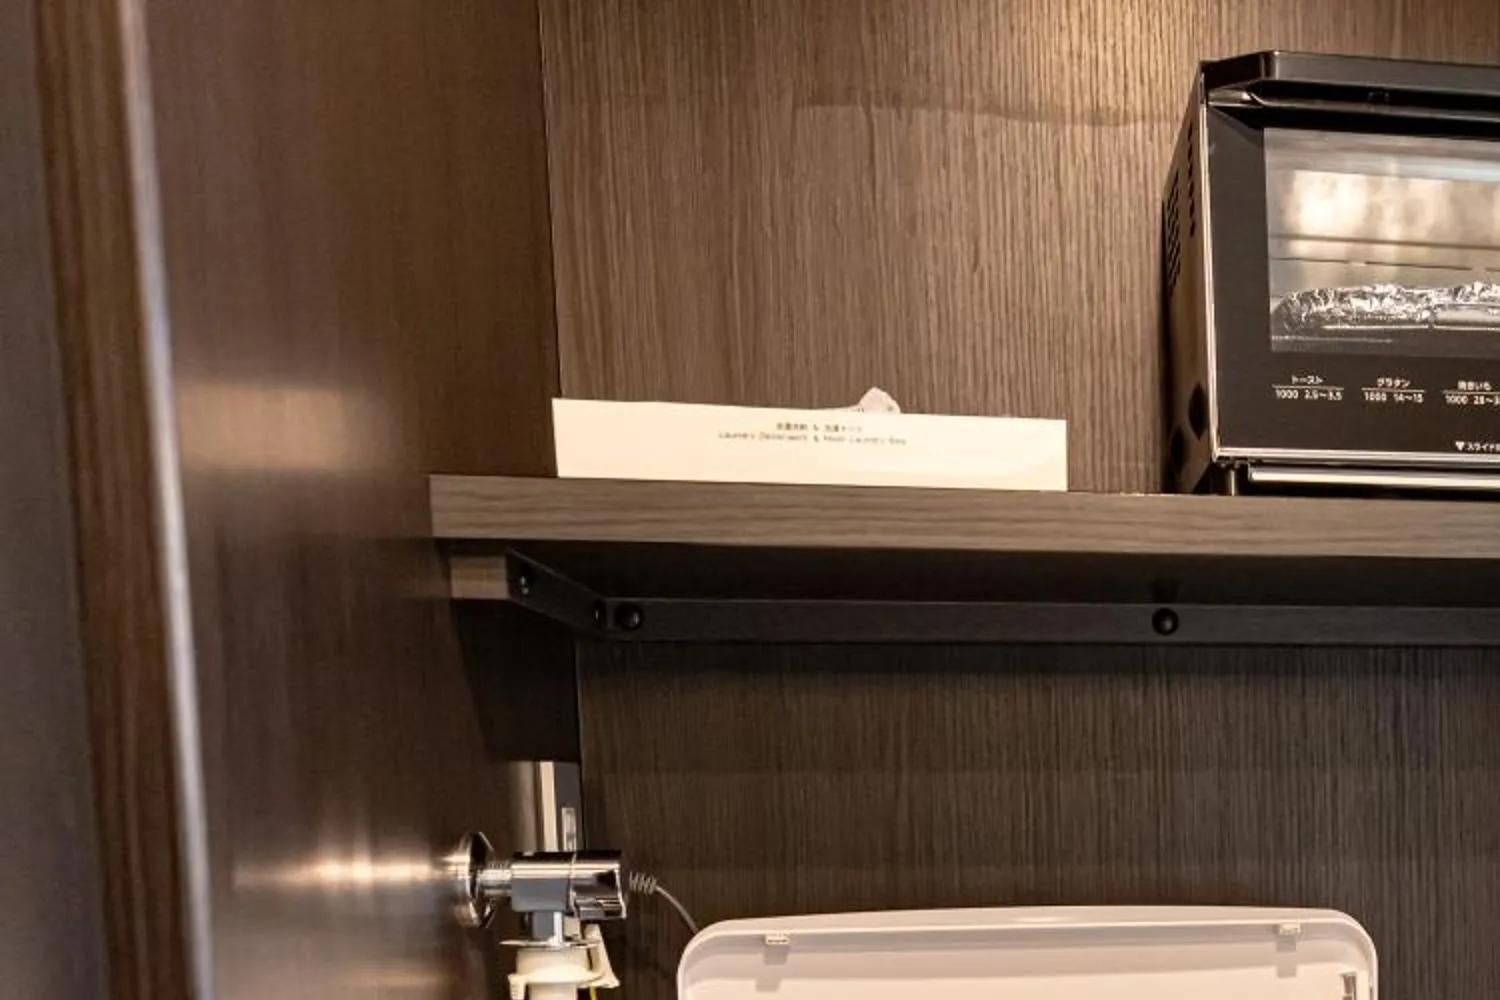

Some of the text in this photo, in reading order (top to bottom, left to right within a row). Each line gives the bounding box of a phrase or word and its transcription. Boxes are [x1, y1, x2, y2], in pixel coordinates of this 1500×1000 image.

[1291, 375, 1323, 385] トースト
[1275, 388, 1299, 399] 1000
